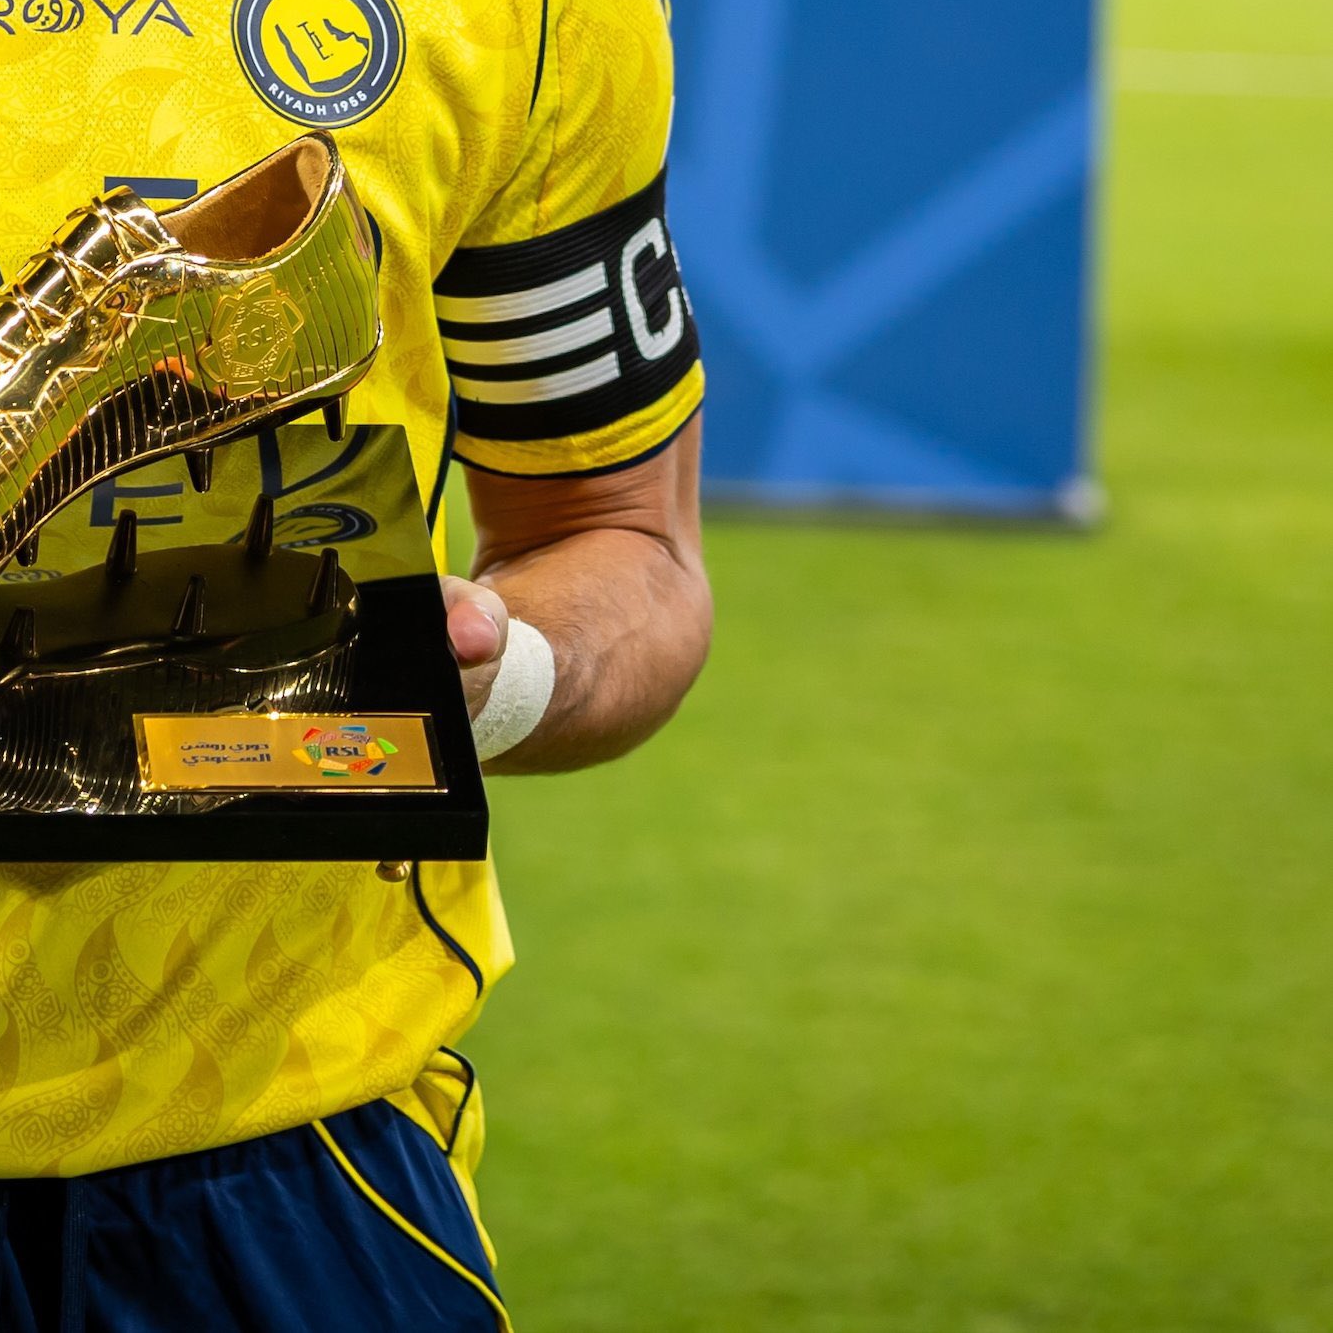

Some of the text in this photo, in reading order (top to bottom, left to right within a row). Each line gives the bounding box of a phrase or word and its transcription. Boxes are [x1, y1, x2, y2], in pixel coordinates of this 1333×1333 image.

[268, 82, 368, 116] RIYADH 1955
[325, 745, 366, 757] RSL
